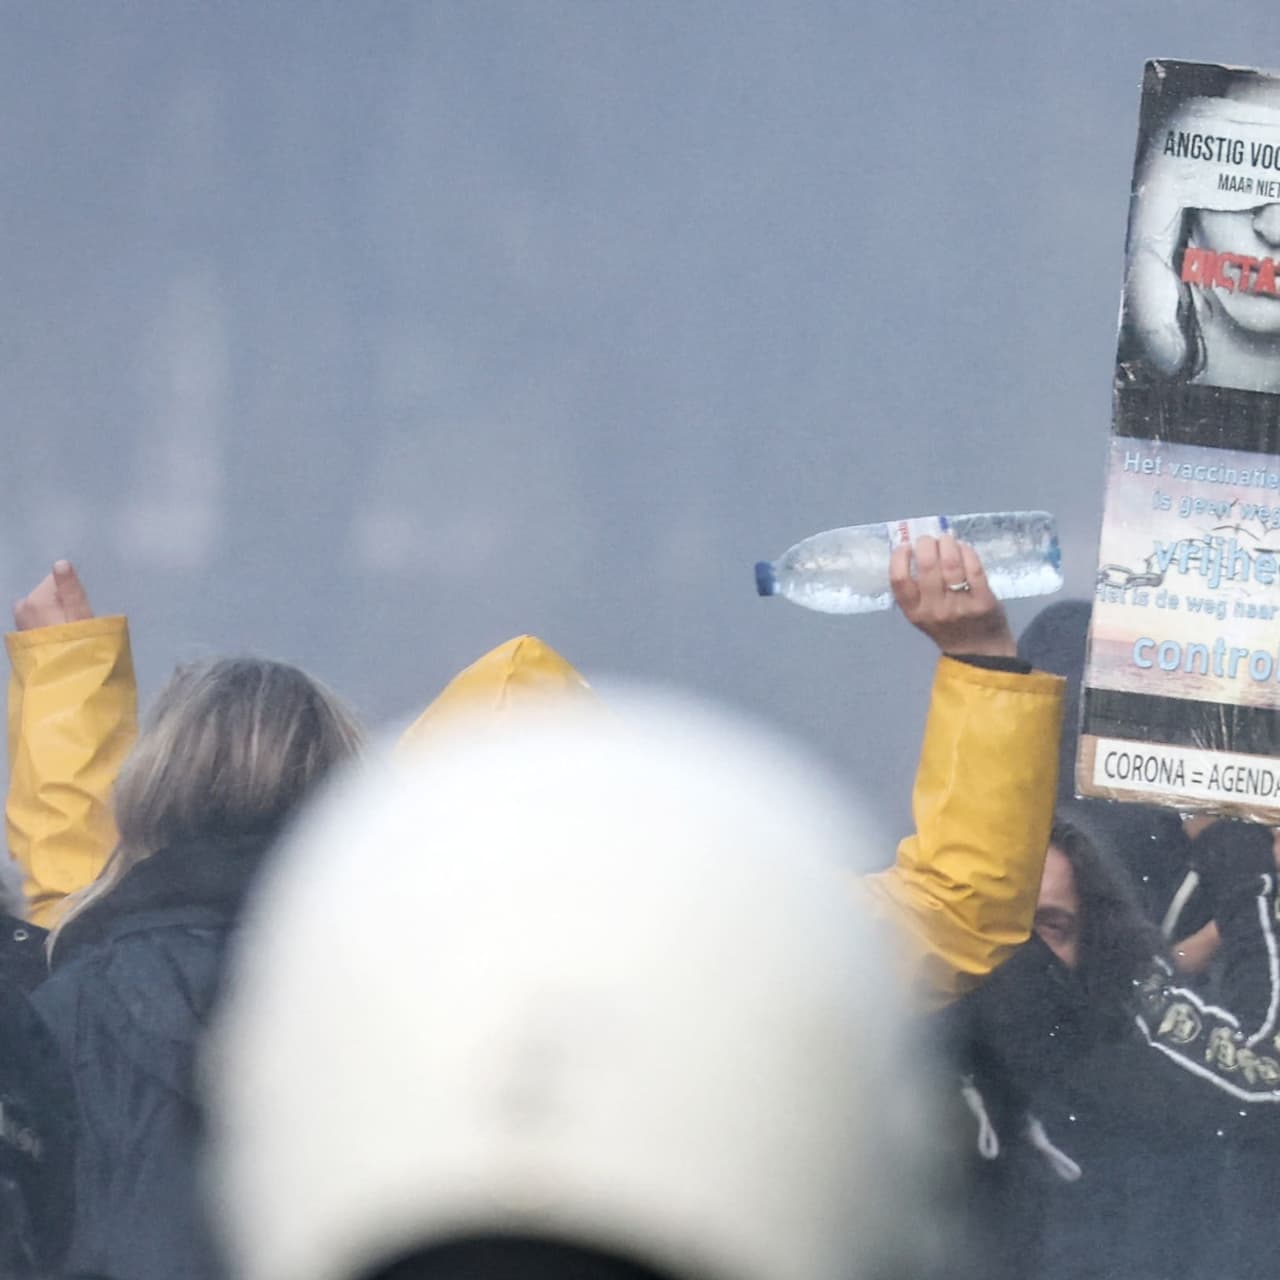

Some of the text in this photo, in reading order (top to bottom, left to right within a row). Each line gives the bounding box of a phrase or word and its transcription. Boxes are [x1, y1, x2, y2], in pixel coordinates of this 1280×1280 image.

[1163, 131, 1245, 165] ANGSTIG
[1217, 173, 1253, 192] MAAR
[1123, 451, 1162, 475] Het
[1152, 490, 1172, 511] is
[1179, 495, 1233, 518] geen
[1156, 588, 1180, 609] de
[1186, 595, 1227, 620] weg
[1234, 602, 1280, 620] naar
[1104, 751, 1186, 787] CORONA
